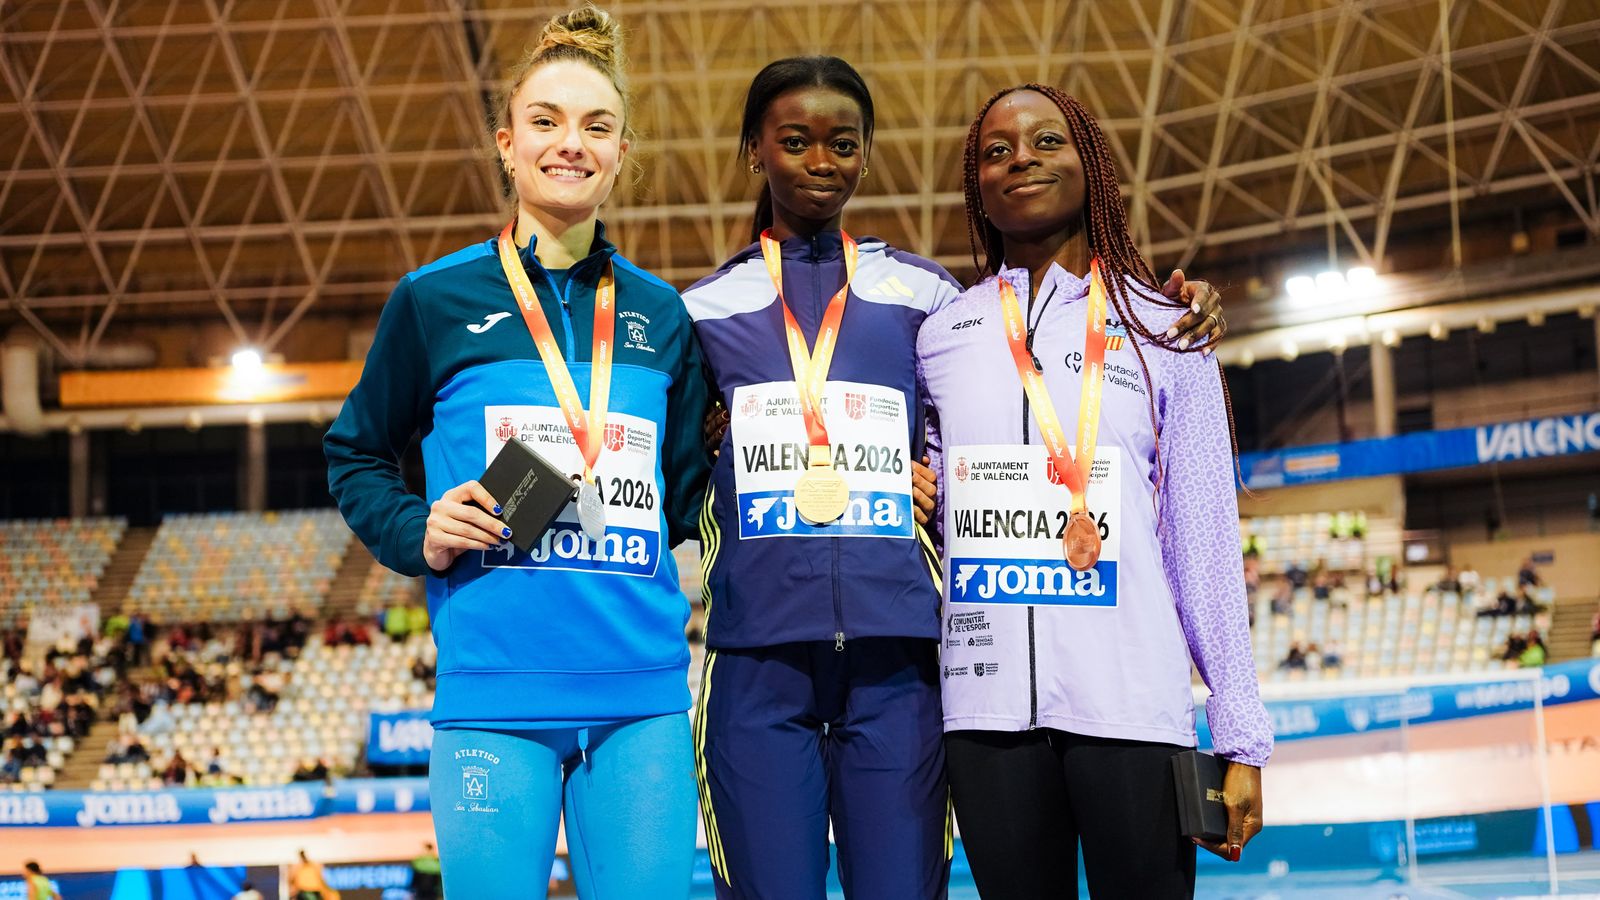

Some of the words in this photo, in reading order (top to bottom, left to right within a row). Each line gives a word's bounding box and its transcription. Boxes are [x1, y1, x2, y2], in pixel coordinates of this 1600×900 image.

[619, 311, 650, 324] ATLETICO
[951, 316, 985, 330] 42K
[1104, 363, 1139, 380] putació
[766, 408, 778, 417] DE
[521, 423, 573, 434] AJUNTAME
[521, 434, 534, 442] DE
[538, 433, 577, 445] VALÈNC
[742, 443, 849, 473] VALENA
[854, 443, 903, 475] 2026
[971, 462, 1029, 470] AJUNTAMENT
[971, 473, 981, 481] DE
[609, 477, 654, 511] 2026
[954, 509, 1051, 539] VALENCIA
[1056, 511, 1109, 541] 26
[455, 749, 500, 765] ATLETICO
